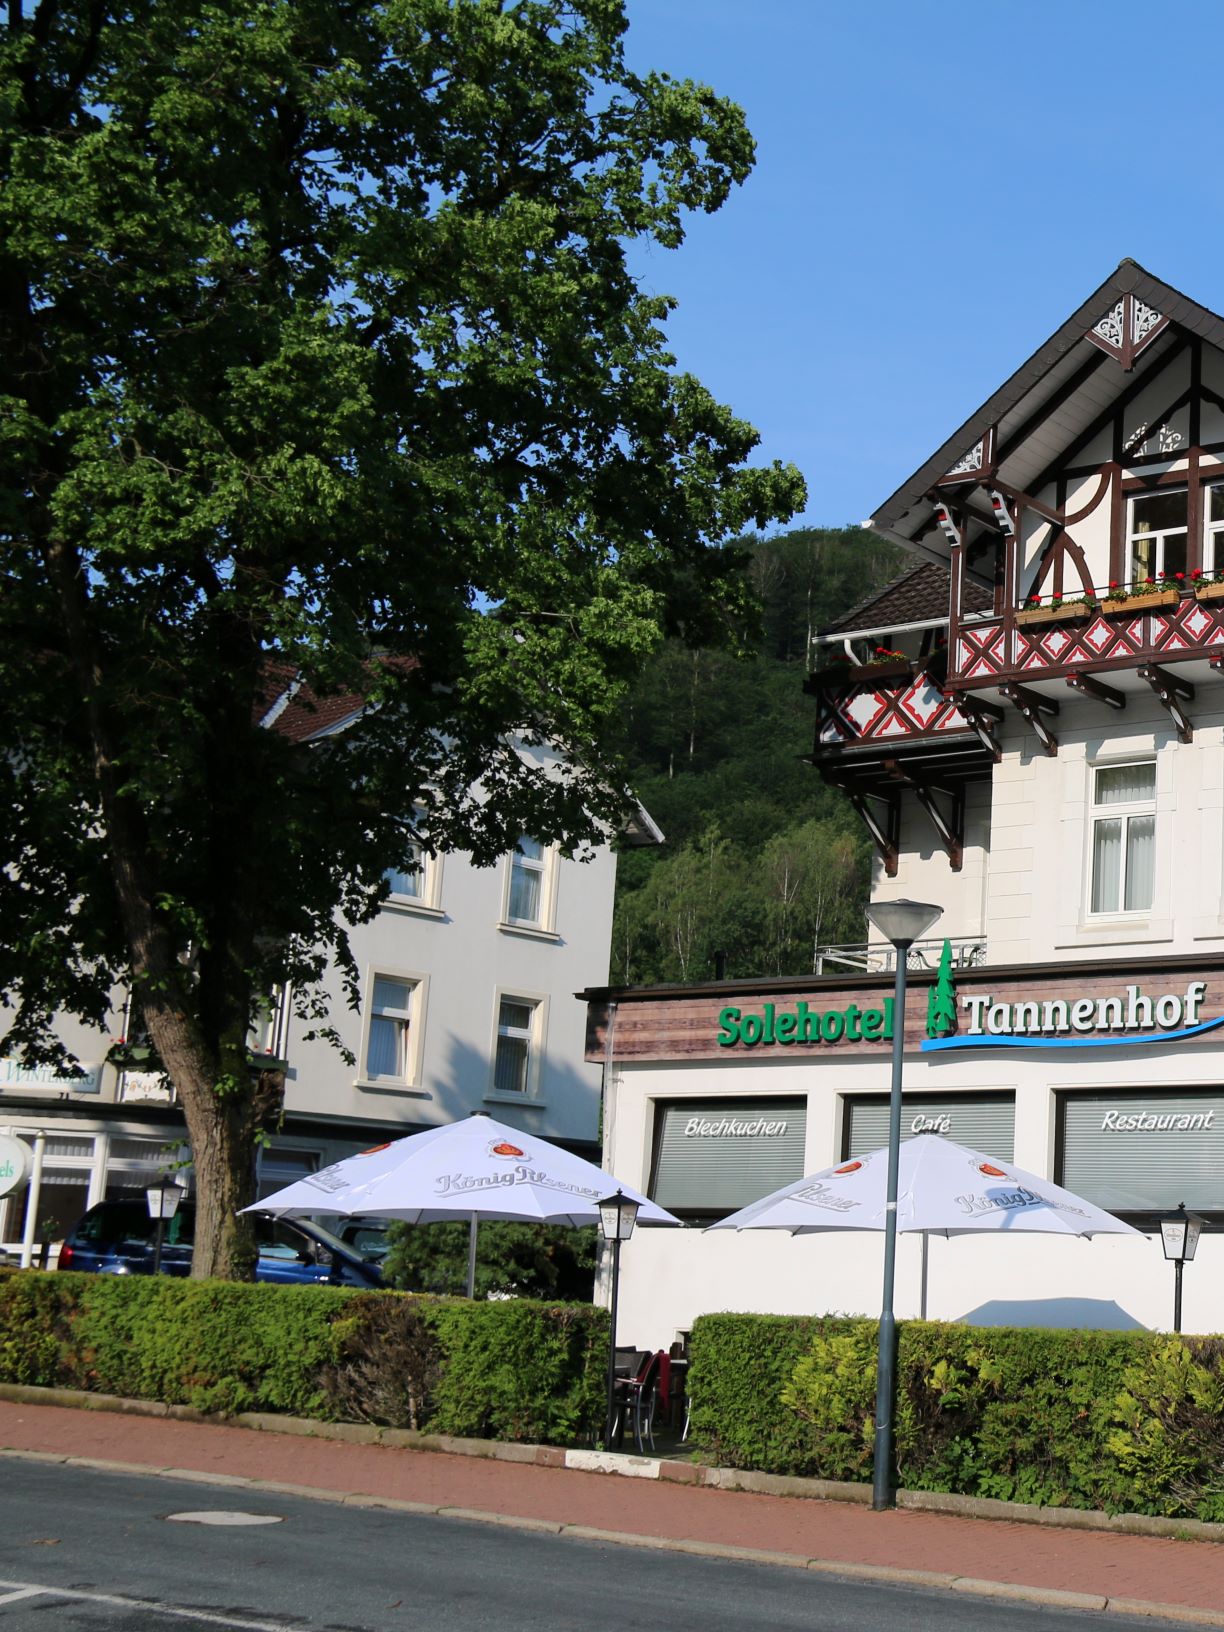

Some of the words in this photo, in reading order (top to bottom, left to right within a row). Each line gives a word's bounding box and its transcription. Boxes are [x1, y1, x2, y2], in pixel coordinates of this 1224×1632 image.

[718, 997, 894, 1046] Solehotel
[962, 982, 1205, 1035] Tannenhof
[684, 1117, 788, 1137] Blechkuchen
[911, 1114, 951, 1133] Café
[1101, 1109, 1214, 1131] Restaurant
[434, 1171, 515, 1195] König
[515, 1165, 603, 1199] Pilsener
[954, 1192, 1021, 1215] König
